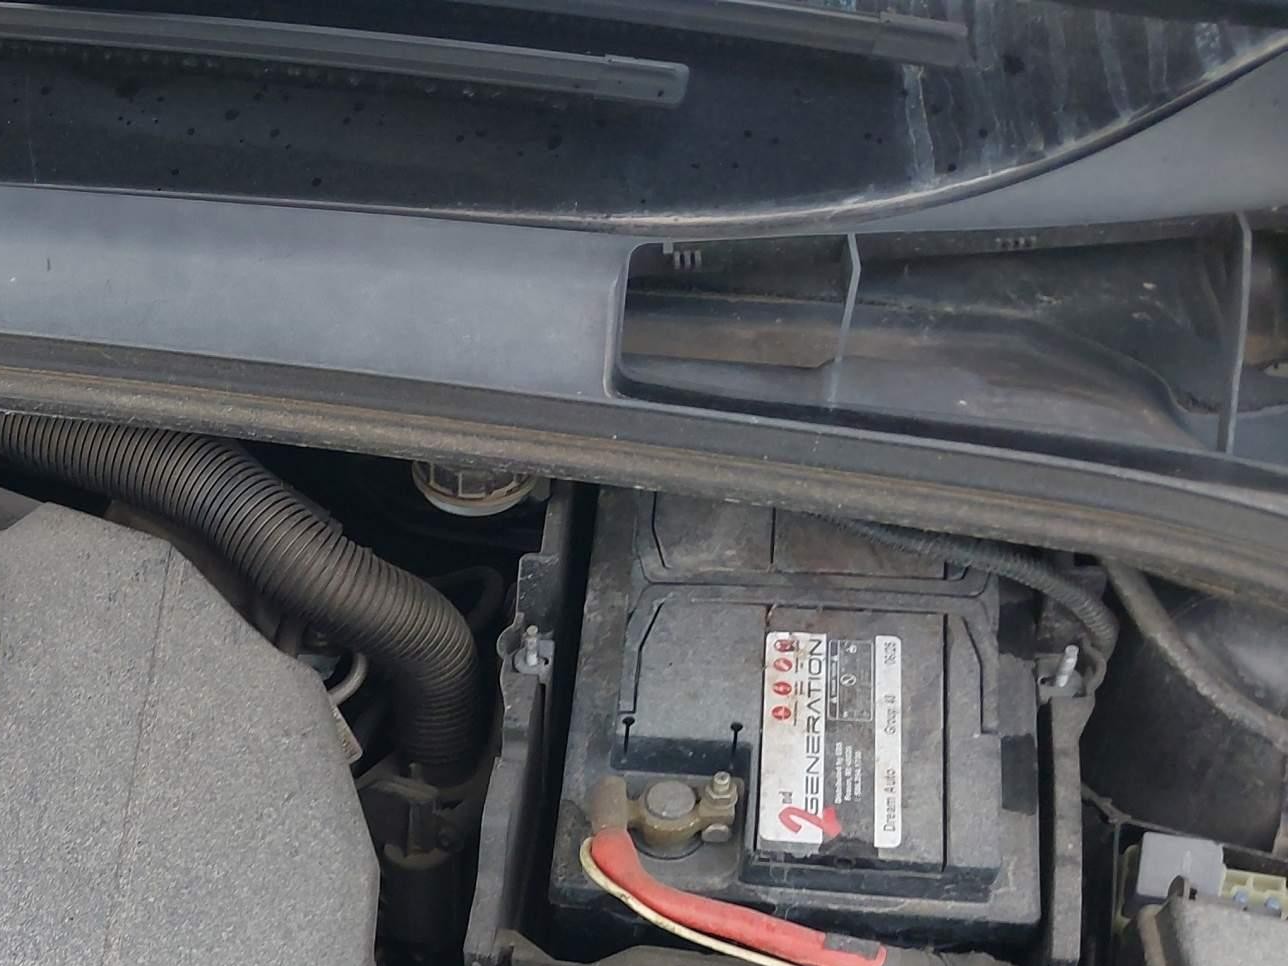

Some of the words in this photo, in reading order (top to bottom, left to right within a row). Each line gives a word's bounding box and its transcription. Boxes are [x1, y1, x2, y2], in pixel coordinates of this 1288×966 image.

[805, 638, 824, 816] GENERATION
[884, 708, 899, 735] Group
[883, 768, 897, 794] Auto
[778, 806, 843, 838] 2
[883, 798, 897, 833] Dream
